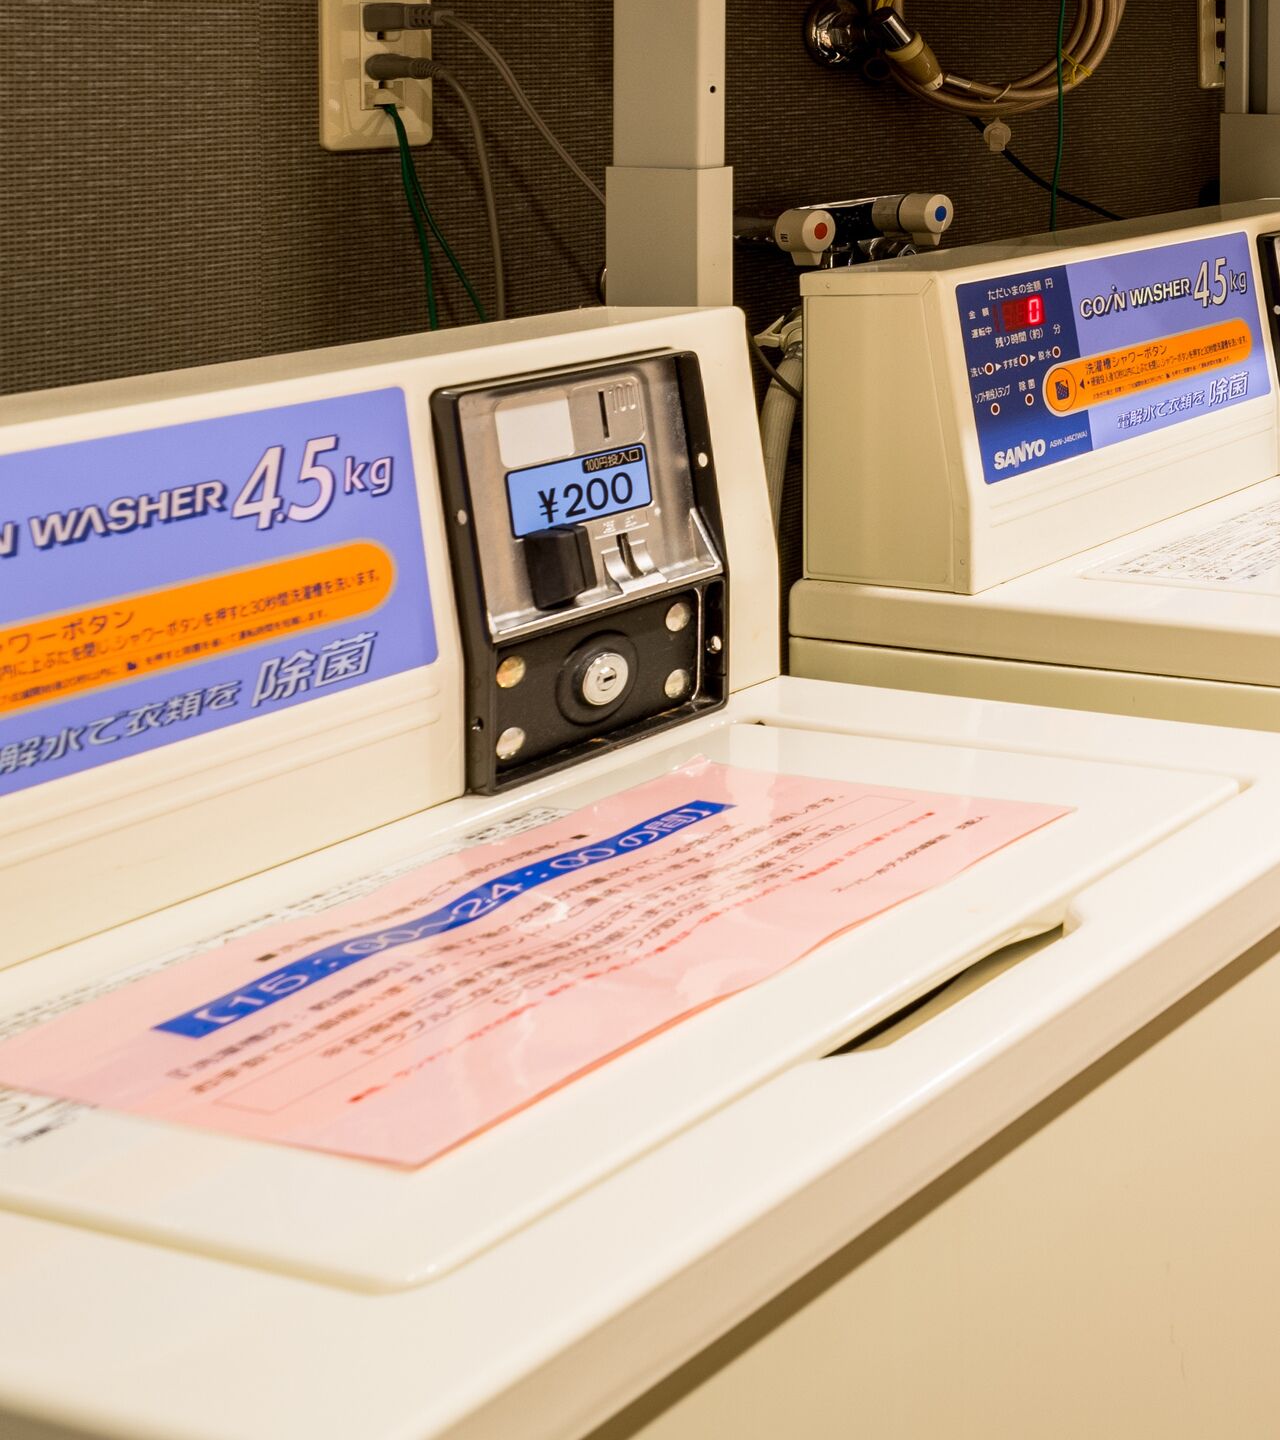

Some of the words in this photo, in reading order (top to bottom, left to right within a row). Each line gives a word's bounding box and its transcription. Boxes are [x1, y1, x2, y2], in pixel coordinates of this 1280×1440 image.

[987, 281, 1042, 301] ただいまの金額
[1045, 278, 1054, 289] 円
[1080, 283, 1127, 320] COIN
[1129, 277, 1193, 308] WASHER
[1193, 256, 1228, 309] 4.5
[1229, 269, 1248, 295] kg
[1028, 297, 1041, 324] 0
[970, 367, 985, 378] 洗い
[1085, 344, 1168, 376] 洗濯槽シャワーボタン
[1116, 390, 1205, 429] 電解水で衣類を
[1207, 370, 1250, 407] 除菌
[584, 449, 641, 472] 100円投入口
[994, 438, 1046, 471] SANYO
[28, 479, 228, 551] WASHER
[230, 432, 339, 533] 4.5
[342, 455, 394, 497] kg
[537, 471, 633, 524] ¥200
[250, 629, 379, 708] 除菌
